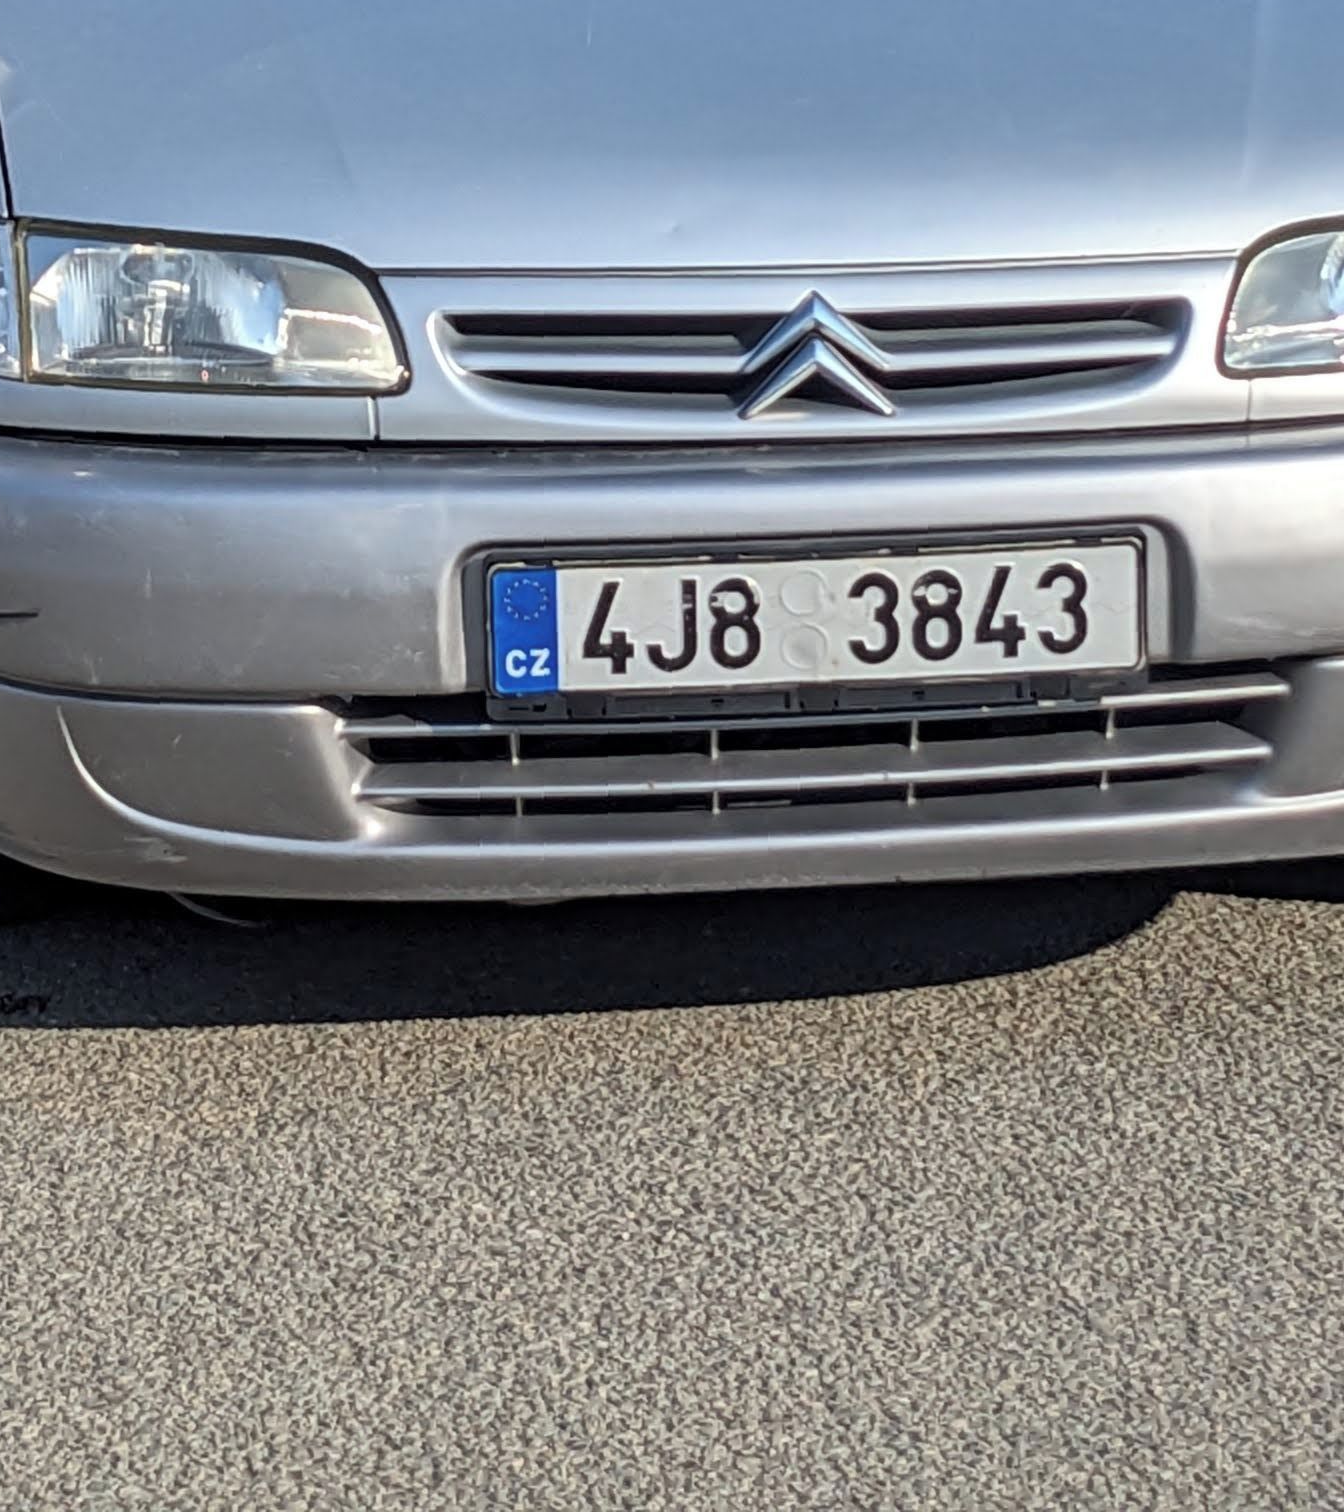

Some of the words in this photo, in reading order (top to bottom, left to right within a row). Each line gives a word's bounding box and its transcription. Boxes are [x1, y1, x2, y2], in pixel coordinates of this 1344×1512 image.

[582, 575, 761, 675] 4J8
[848, 561, 1088, 665] 3843
[505, 647, 551, 678] CZ
